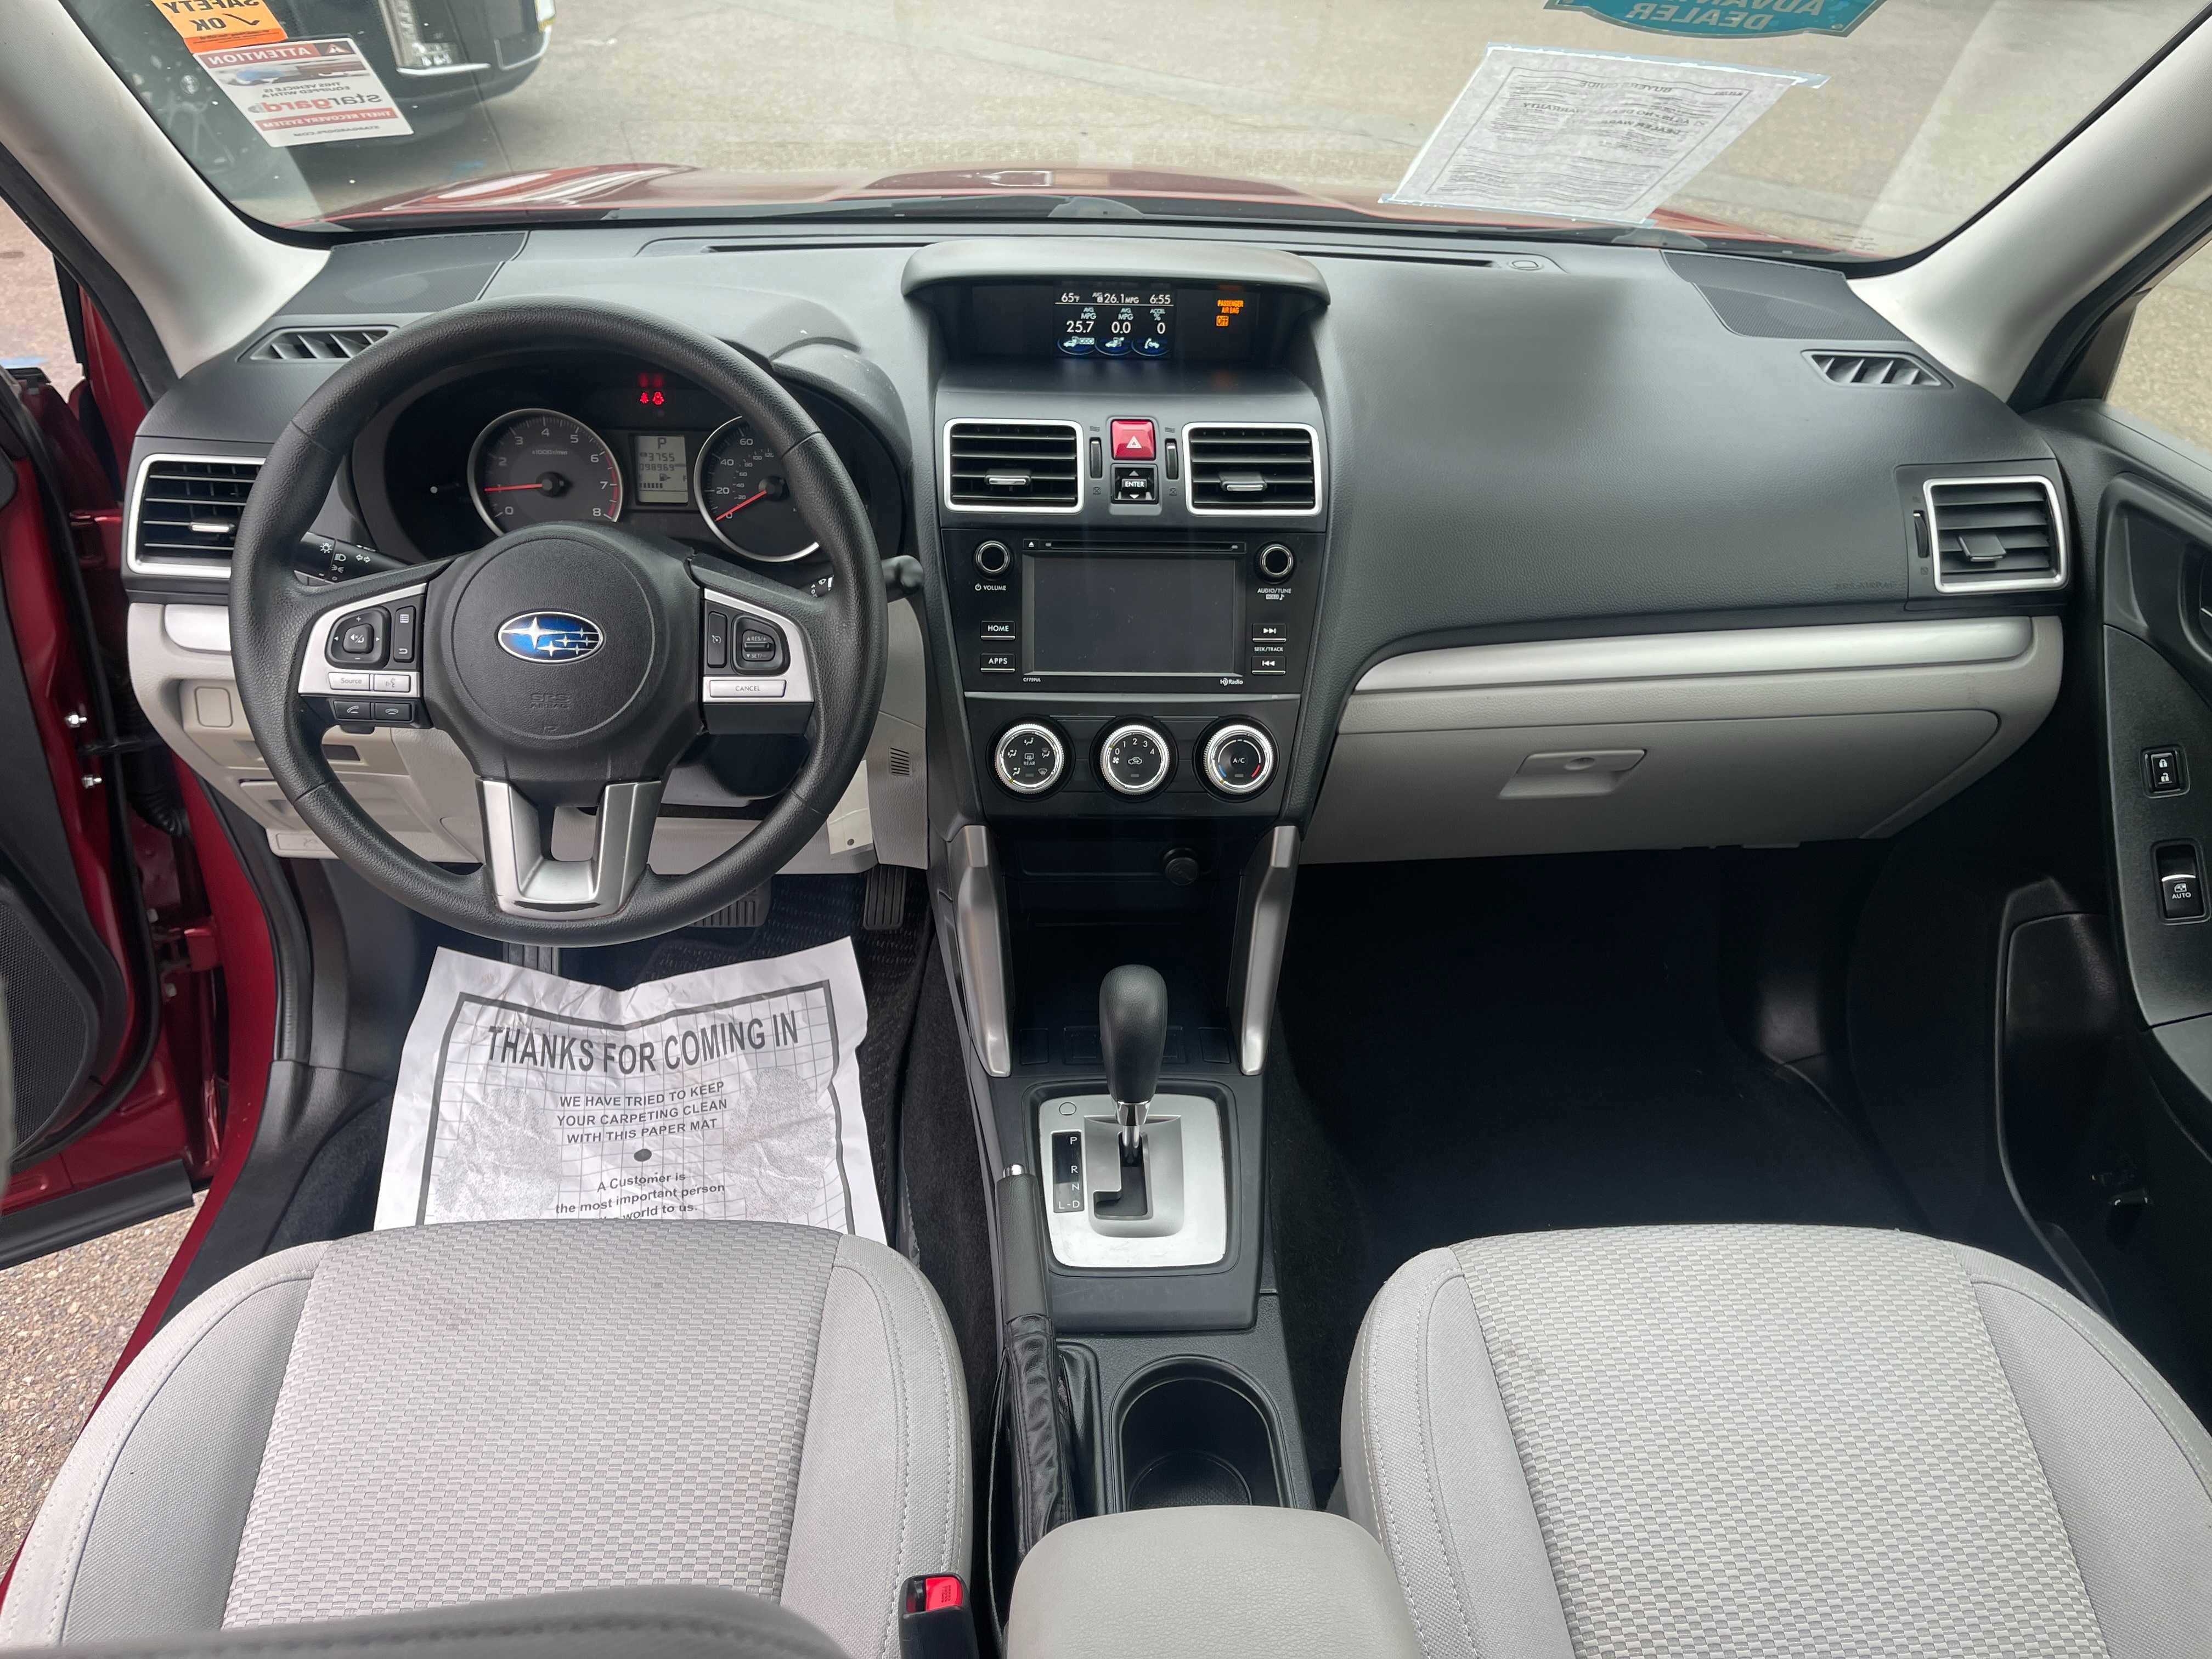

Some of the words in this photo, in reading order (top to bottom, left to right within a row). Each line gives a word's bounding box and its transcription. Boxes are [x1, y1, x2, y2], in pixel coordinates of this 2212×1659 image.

[1149, 295, 1171, 304] 6:55
[1217, 316, 1228, 325] OFF
[1066, 321, 1094, 333] 25.7
[1111, 321, 1131, 334] 0.0
[1157, 322, 1166, 334] 0
[541, 428, 550, 437] 4
[515, 436, 523, 445] 3
[570, 435, 579, 443] 5
[657, 437, 667, 449] P
[499, 456, 507, 466] 2
[590, 454, 599, 462] 6
[600, 481, 608, 489] 7
[505, 506, 514, 515] 0
[592, 508, 601, 516] 8
[488, 1026, 594, 1071] THANKS
[603, 1042, 656, 1075] FOR
[664, 1018, 765, 1069] COMING
[772, 1011, 798, 1047] IN
[560, 1097, 580, 1107] WE
[586, 1096, 621, 1107] HAVE
[625, 1094, 664, 1106] TRIED
[669, 1090, 686, 1101] TO
[691, 1081, 724, 1096] KEEP
[557, 1115, 595, 1126] YOUR
[600, 1108, 678, 1125] CARPETING
[683, 1099, 727, 1115] CLEAN
[567, 1132, 601, 1144] WITH
[606, 1130, 636, 1141] THIS
[641, 1124, 686, 1137] PAPER
[690, 1119, 718, 1131] MAT
[1070, 1137, 1077, 1145] P
[597, 1182, 606, 1193] A
[610, 1175, 671, 1189] Customer
[675, 1172, 685, 1181] is
[556, 1204, 575, 1214] the
[580, 1199, 613, 1212] most
[616, 1188, 678, 1206] important
[681, 1185, 725, 1199] person
[623, 1205, 658, 1219] world
[662, 1205, 674, 1214] to
[679, 1204, 698, 1212] us.
